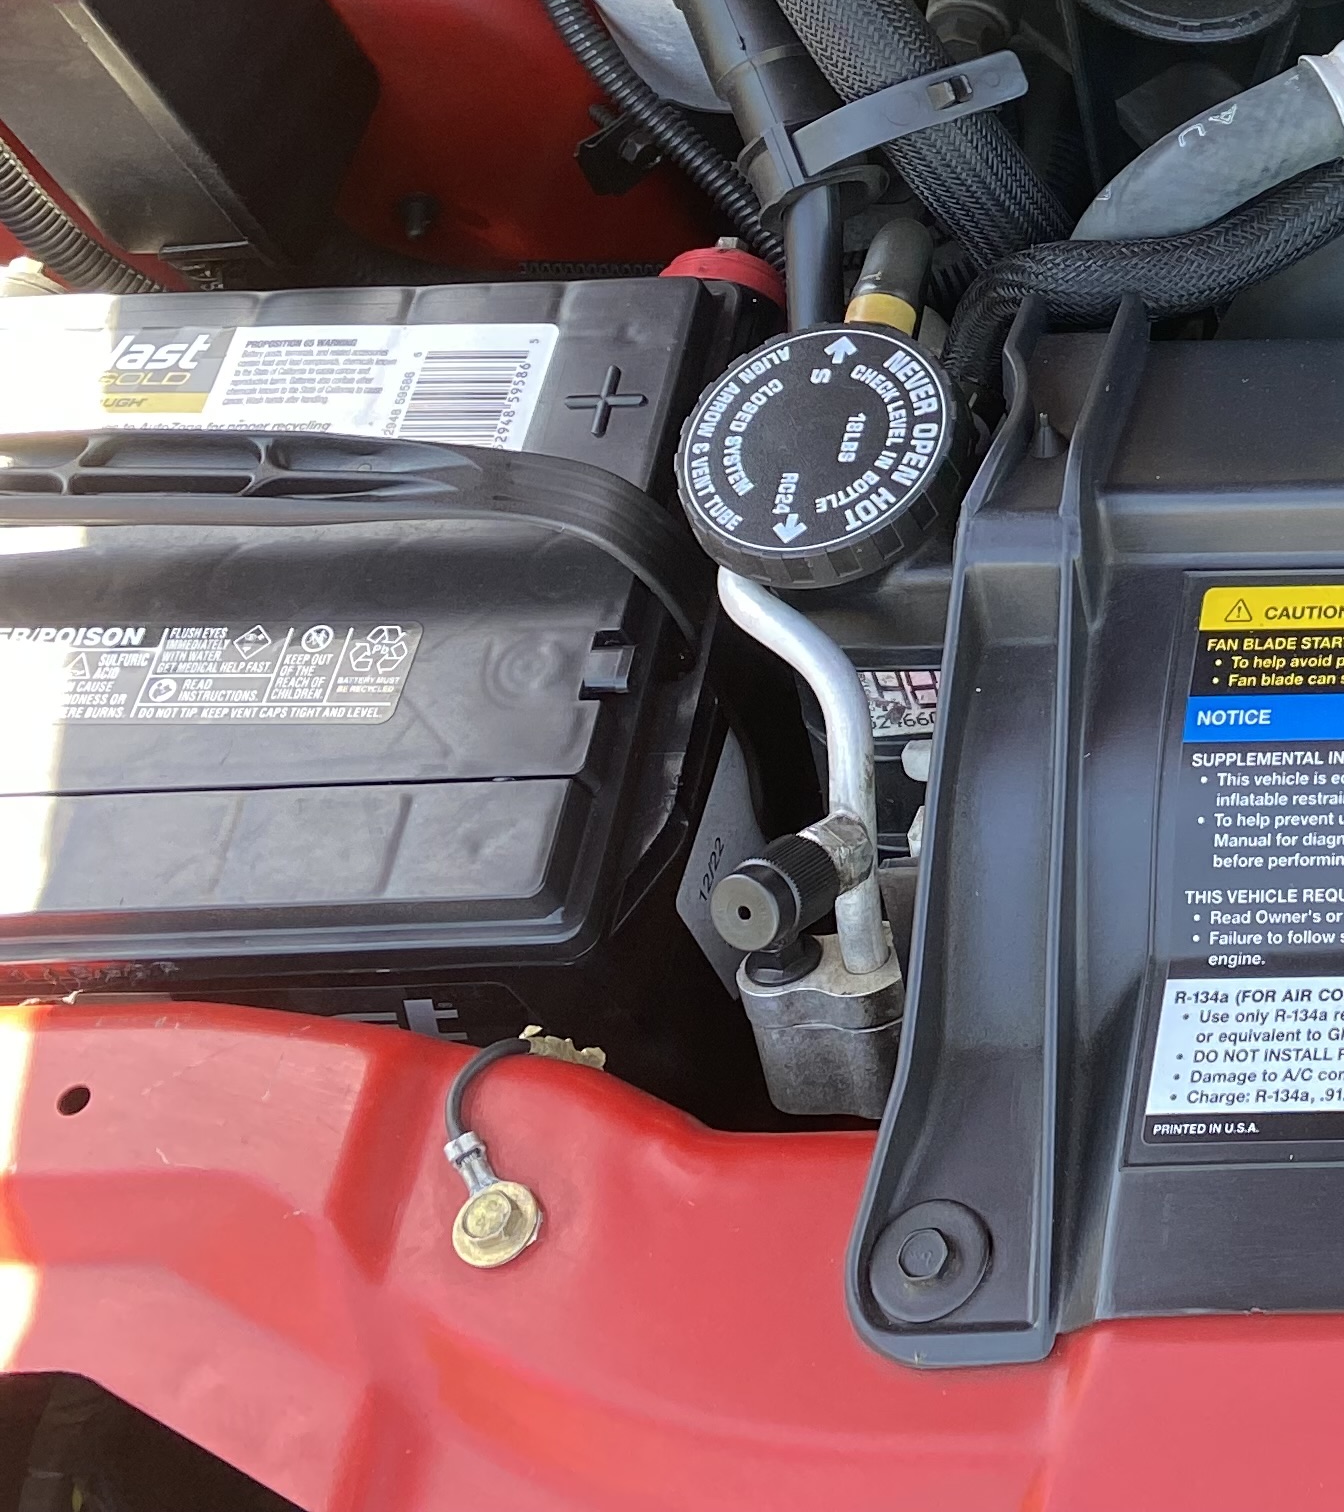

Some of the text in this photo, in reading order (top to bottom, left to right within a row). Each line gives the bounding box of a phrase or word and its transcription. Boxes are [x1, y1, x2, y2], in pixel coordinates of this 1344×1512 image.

[738, 347, 790, 384] ALIGN
[697, 381, 741, 438] ARROW
[722, 378, 784, 497] CLOSED SYSTEM
[815, 364, 907, 513] CHECK LEVEL IN BOTTLE
[846, 350, 938, 531] NEVER OPEN HOT
[691, 458, 713, 497] VENT
[704, 495, 744, 532] TUBE
[170, 628, 227, 639] FLUSH EYES
[165, 639, 230, 650] IMMEDIATELY
[1207, 638, 1239, 651] FAN
[1243, 637, 1298, 650] BLADE
[98, 653, 150, 666] SULFURIC
[161, 651, 186, 662] WITH
[284, 654, 333, 665] KEEP OUT
[1231, 656, 1249, 669] To
[1253, 655, 1286, 670] help
[1290, 654, 1332, 667] avoid
[92, 667, 120, 679] ACID
[280, 666, 315, 676] OF THE
[182, 679, 213, 690] READ
[275, 677, 326, 688] REACH OF
[178, 690, 259, 702] INSTRUCTIONS.
[270, 689, 323, 700] CHILDREN.
[1197, 709, 1271, 725] NOTICE
[1192, 751, 1324, 767] SUPPLEMENTAL
[698, 836, 725, 902] 12/22
[1185, 890, 1223, 904] THIS
[1227, 889, 1298, 904] VEHICLE
[1175, 991, 1229, 1004] R-134a
[1236, 990, 1277, 1006] (FOR
[1282, 989, 1312, 1002] AIR
[1187, 1090, 1250, 1106] Charge:
[1255, 1089, 1314, 1104] R-134a,
[1153, 1122, 1259, 1135] PRINTED IN U.S.A.
